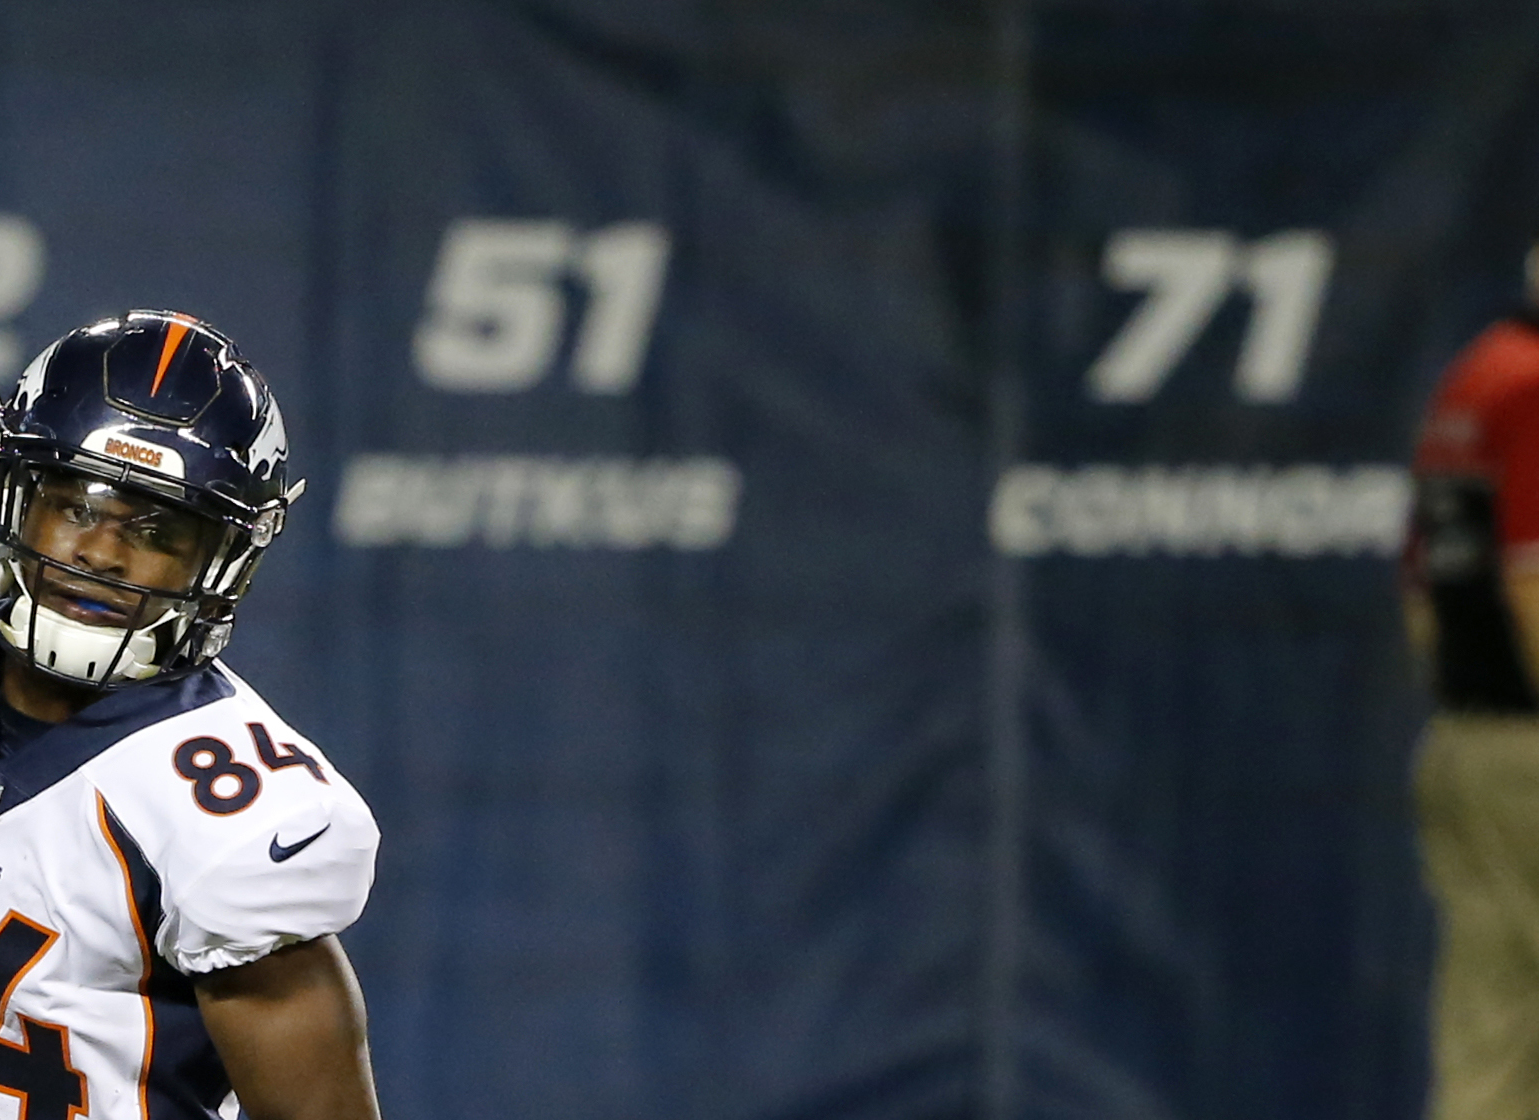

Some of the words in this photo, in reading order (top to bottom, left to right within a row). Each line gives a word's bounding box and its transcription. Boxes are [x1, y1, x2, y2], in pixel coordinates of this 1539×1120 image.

[412, 218, 671, 394] 51
[1088, 227, 1335, 403] 71
[104, 437, 163, 468] BRONCOS
[333, 454, 742, 550] BUTKUS
[171, 722, 330, 817] 84
